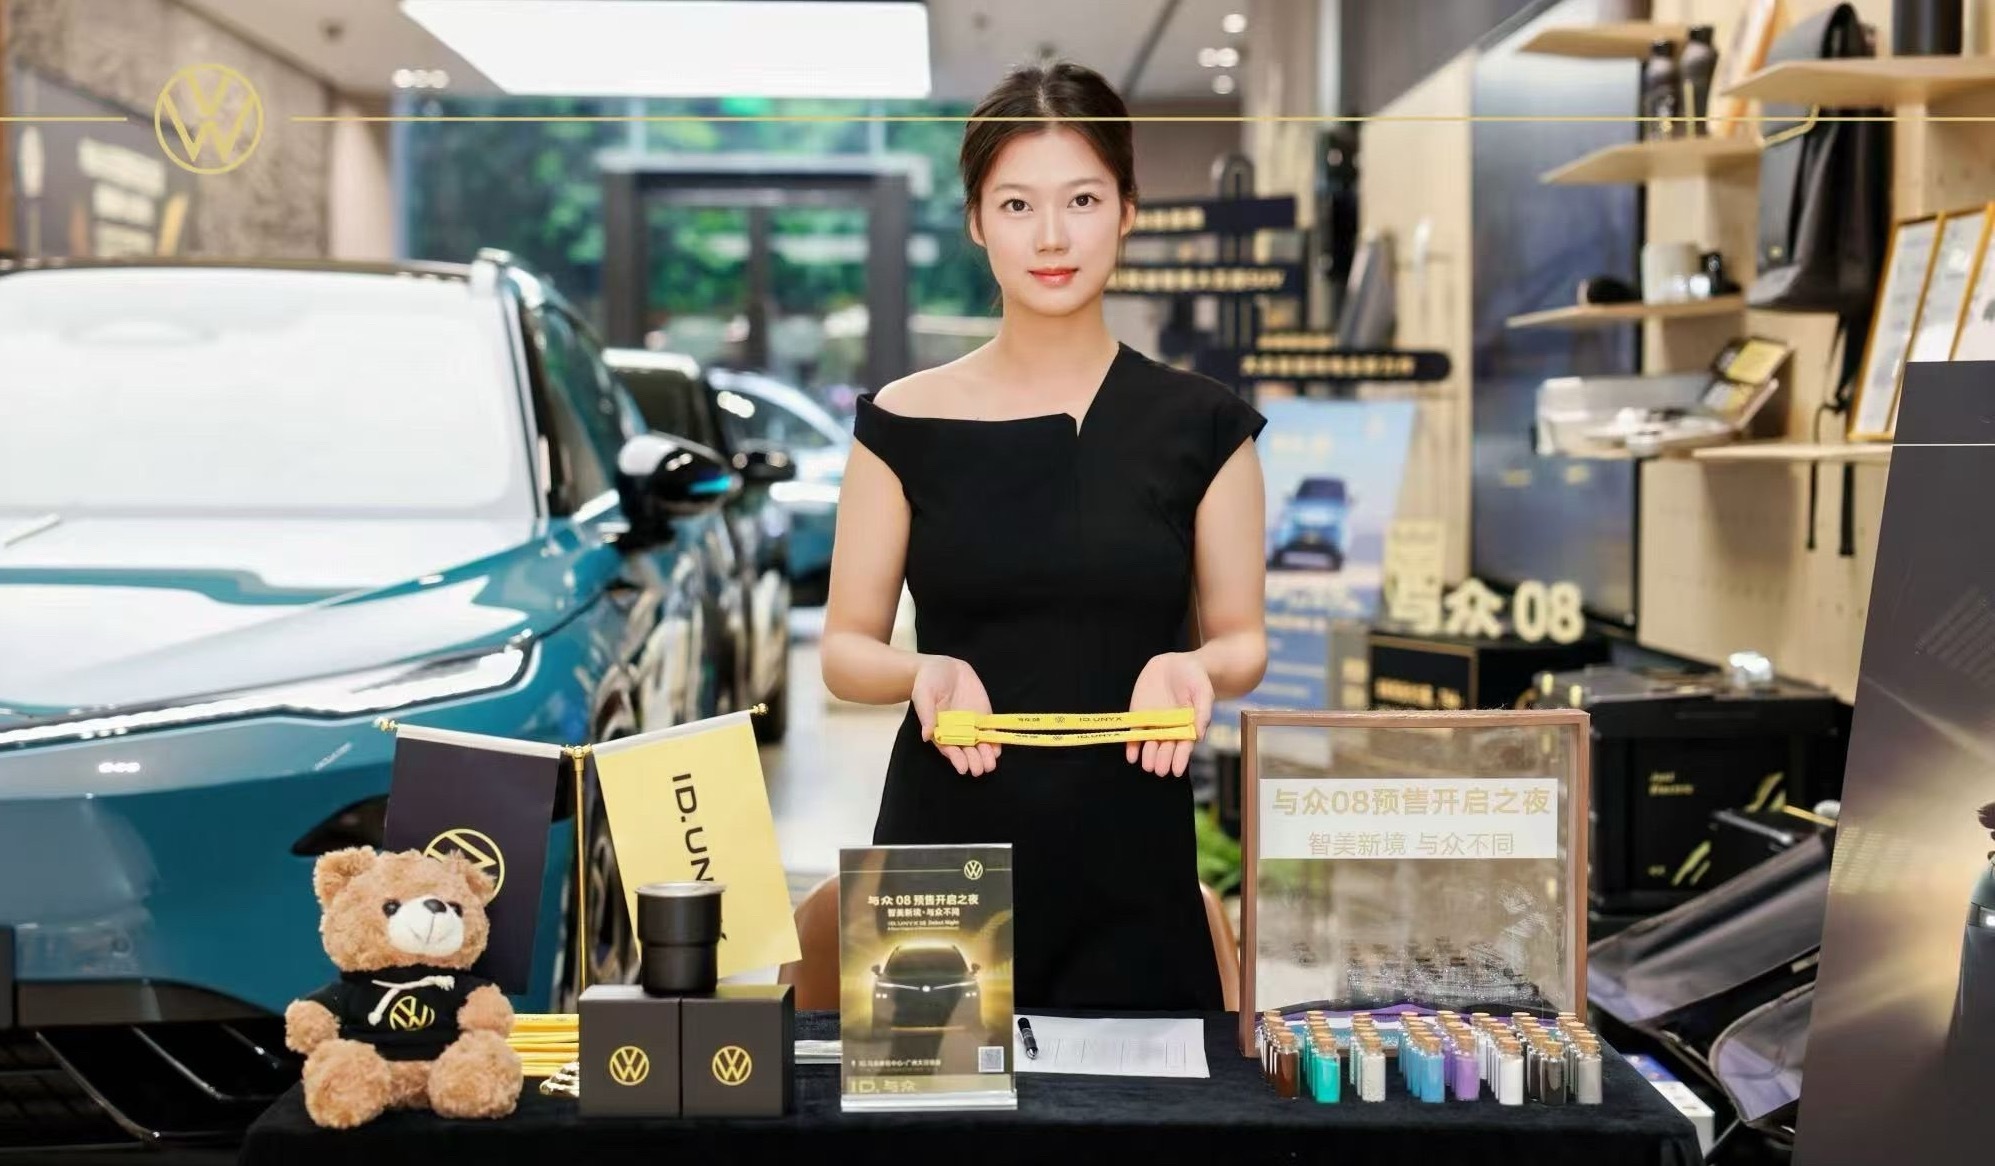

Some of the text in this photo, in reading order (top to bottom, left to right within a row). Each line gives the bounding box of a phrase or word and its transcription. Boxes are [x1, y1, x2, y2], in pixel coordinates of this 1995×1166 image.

[1512, 579, 1585, 645] 08
[1271, 787, 1551, 816] 与众08预售开启之夜
[1307, 831, 1514, 856] 智美新境 与众不同
[897, 895, 911, 905] 08
